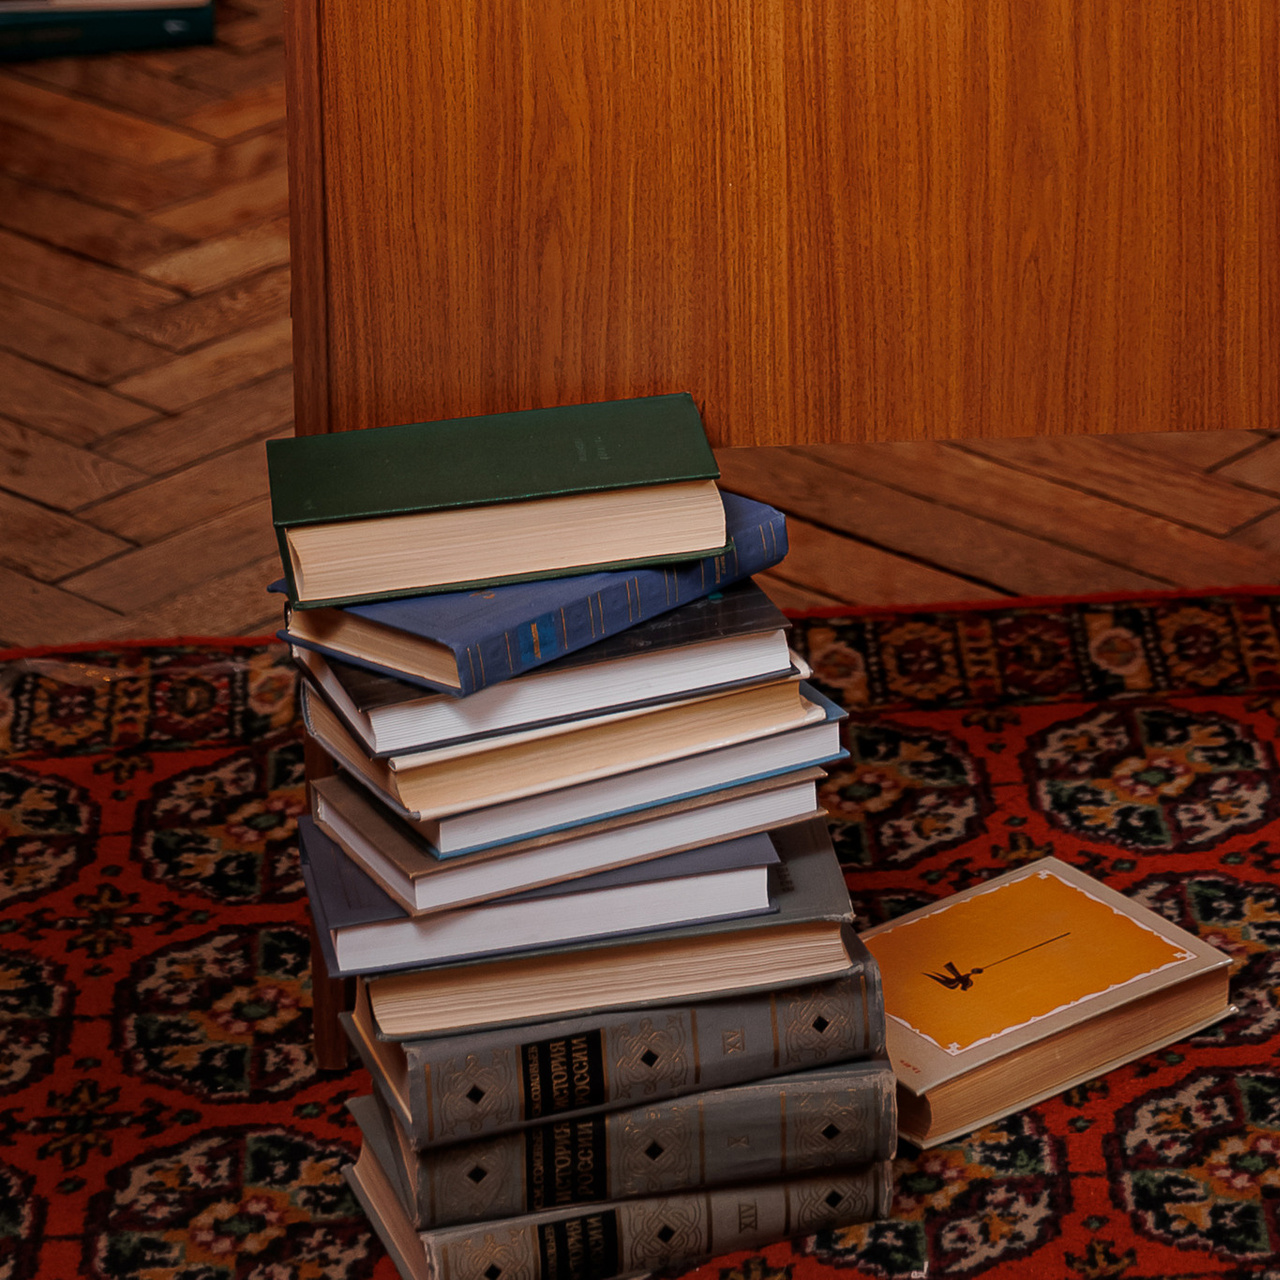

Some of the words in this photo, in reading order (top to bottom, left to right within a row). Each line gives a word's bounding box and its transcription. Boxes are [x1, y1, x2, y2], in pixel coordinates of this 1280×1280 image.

[550, 1040, 569, 1111] ИСТОРИЯ
[571, 1035, 590, 1107] РОССИИ
[722, 1027, 745, 1055] XV
[554, 1122, 572, 1203] ИСТОРИЯ
[577, 1121, 594, 1196] РОССИИ
[727, 1134, 749, 1147] X
[738, 1203, 757, 1234] XIV
